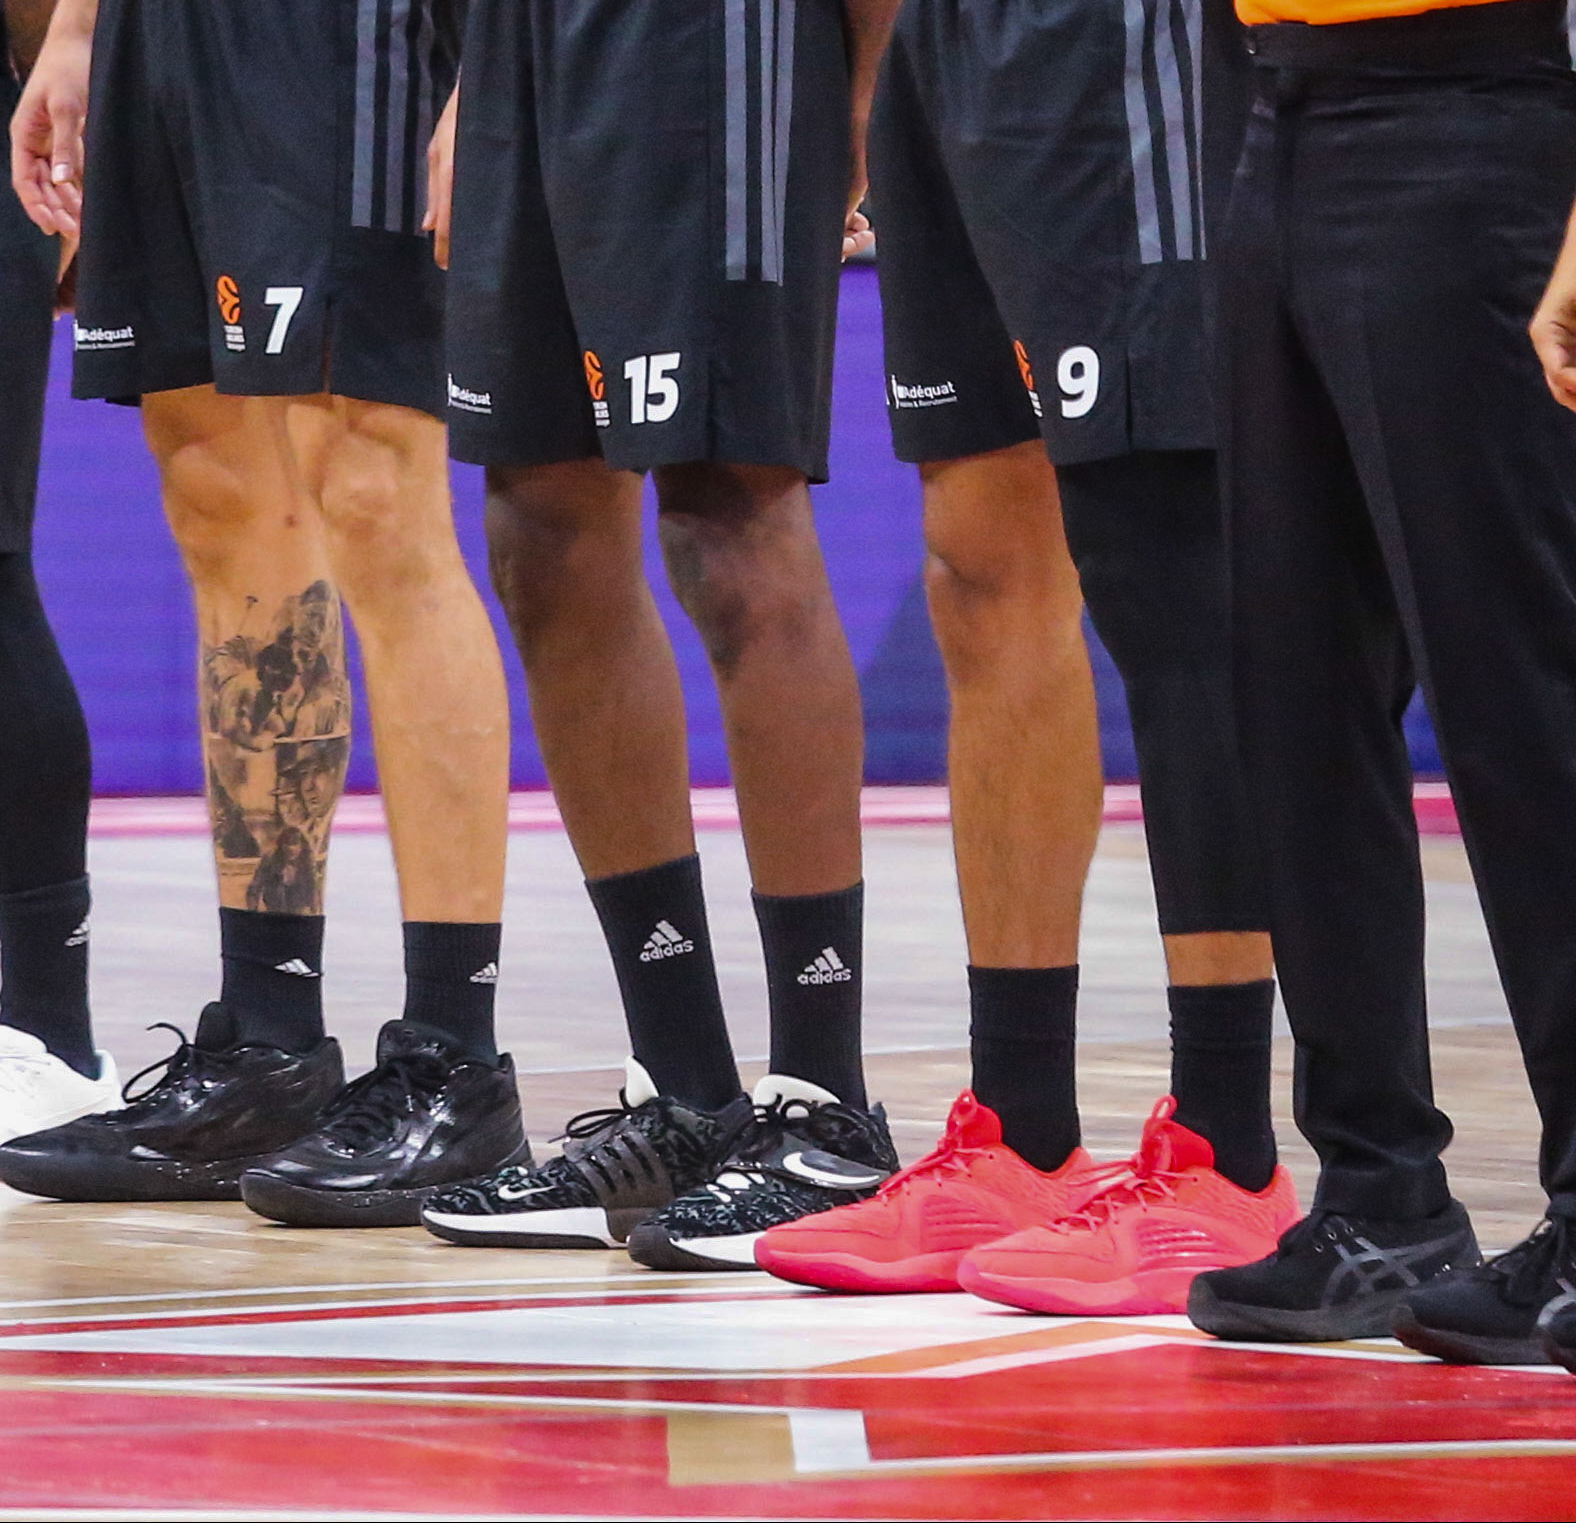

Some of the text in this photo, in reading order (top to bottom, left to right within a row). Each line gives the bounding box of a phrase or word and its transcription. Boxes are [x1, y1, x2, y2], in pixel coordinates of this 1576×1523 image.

[264, 287, 303, 354] 7
[624, 352, 681, 424] 15
[903, 380, 956, 399] Adéquat
[1057, 345, 1100, 419] 9
[639, 939, 694, 963] adidas
[797, 968, 852, 985] adidas
